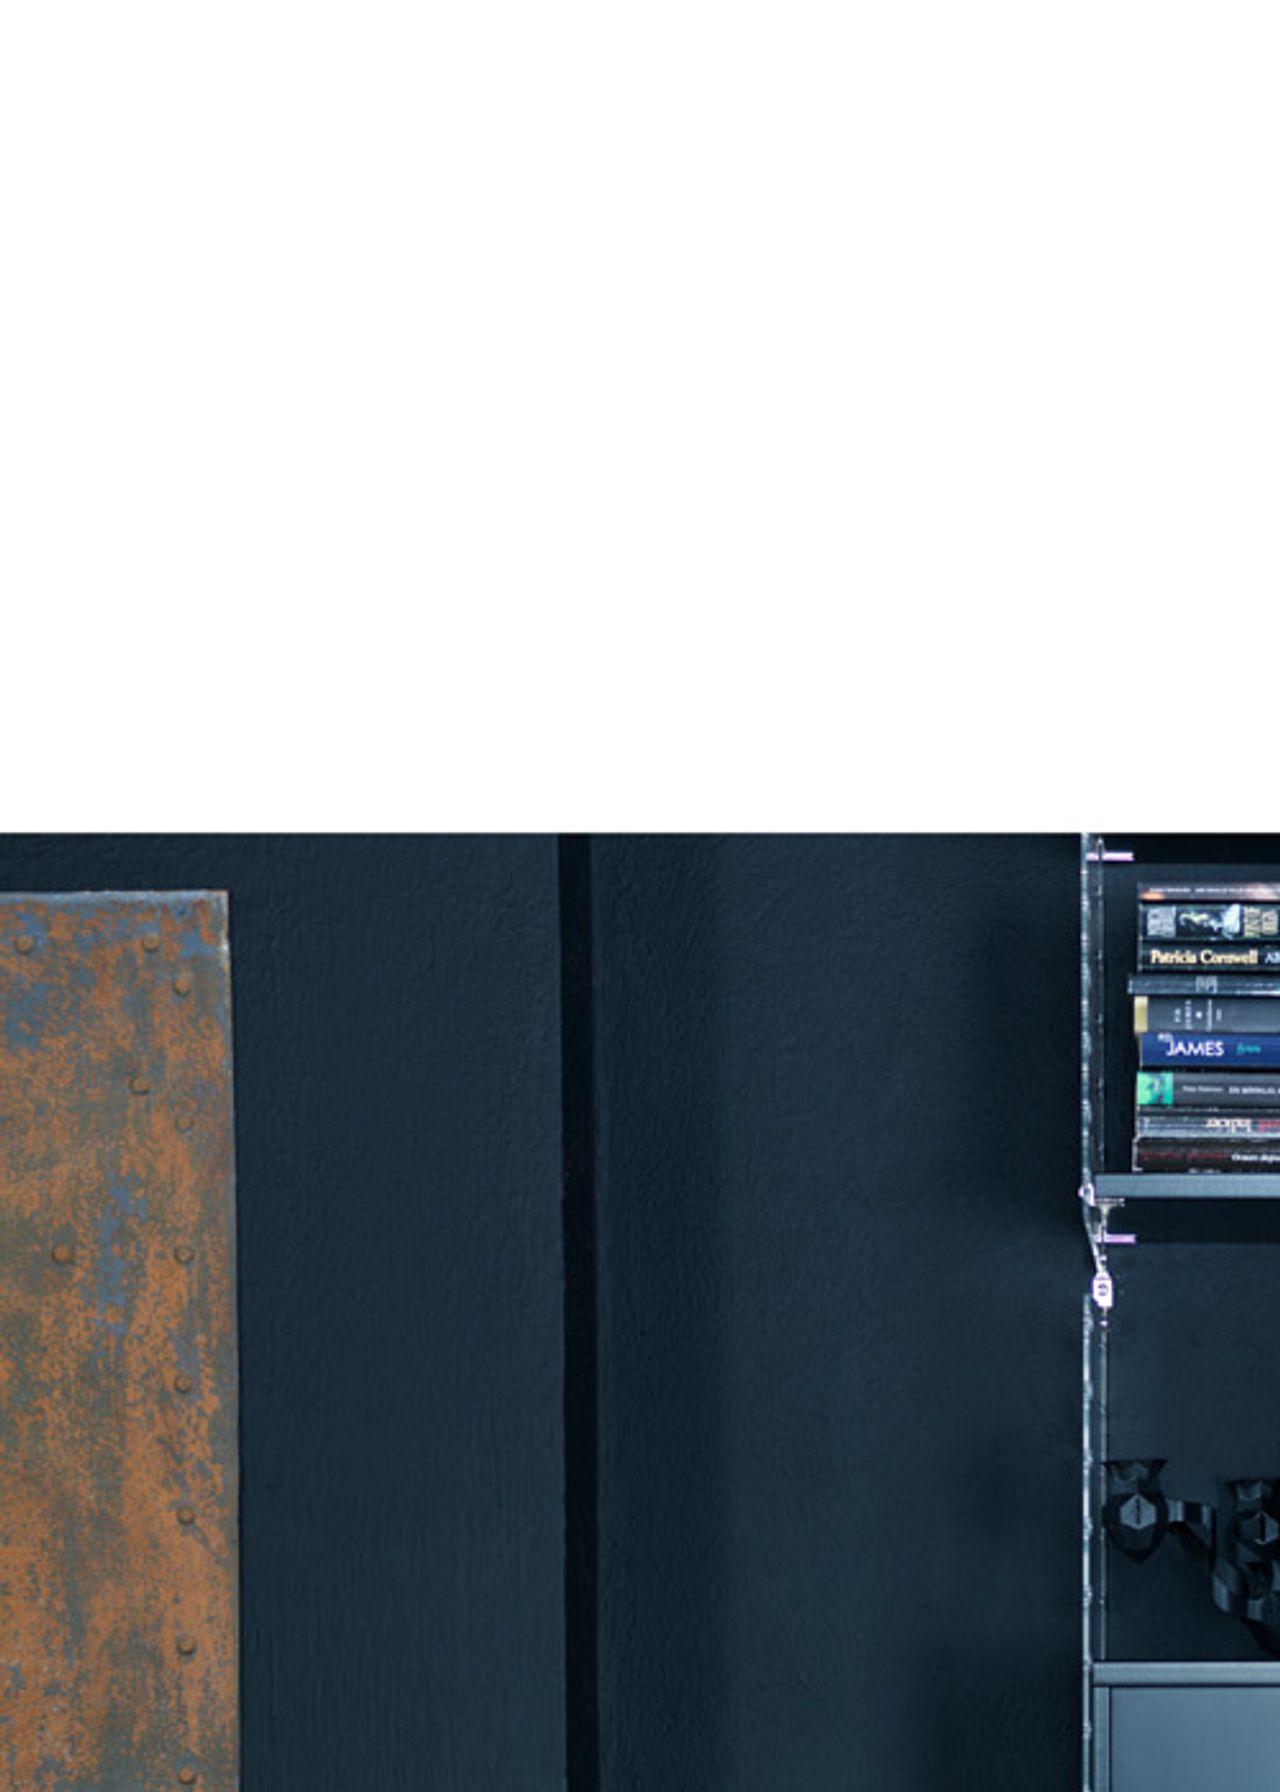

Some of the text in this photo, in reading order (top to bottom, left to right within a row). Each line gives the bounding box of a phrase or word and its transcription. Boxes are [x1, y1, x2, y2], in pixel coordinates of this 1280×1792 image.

[1150, 947, 1259, 965] Patricia Cornwell
[1166, 1041, 1224, 1057] JAMES
